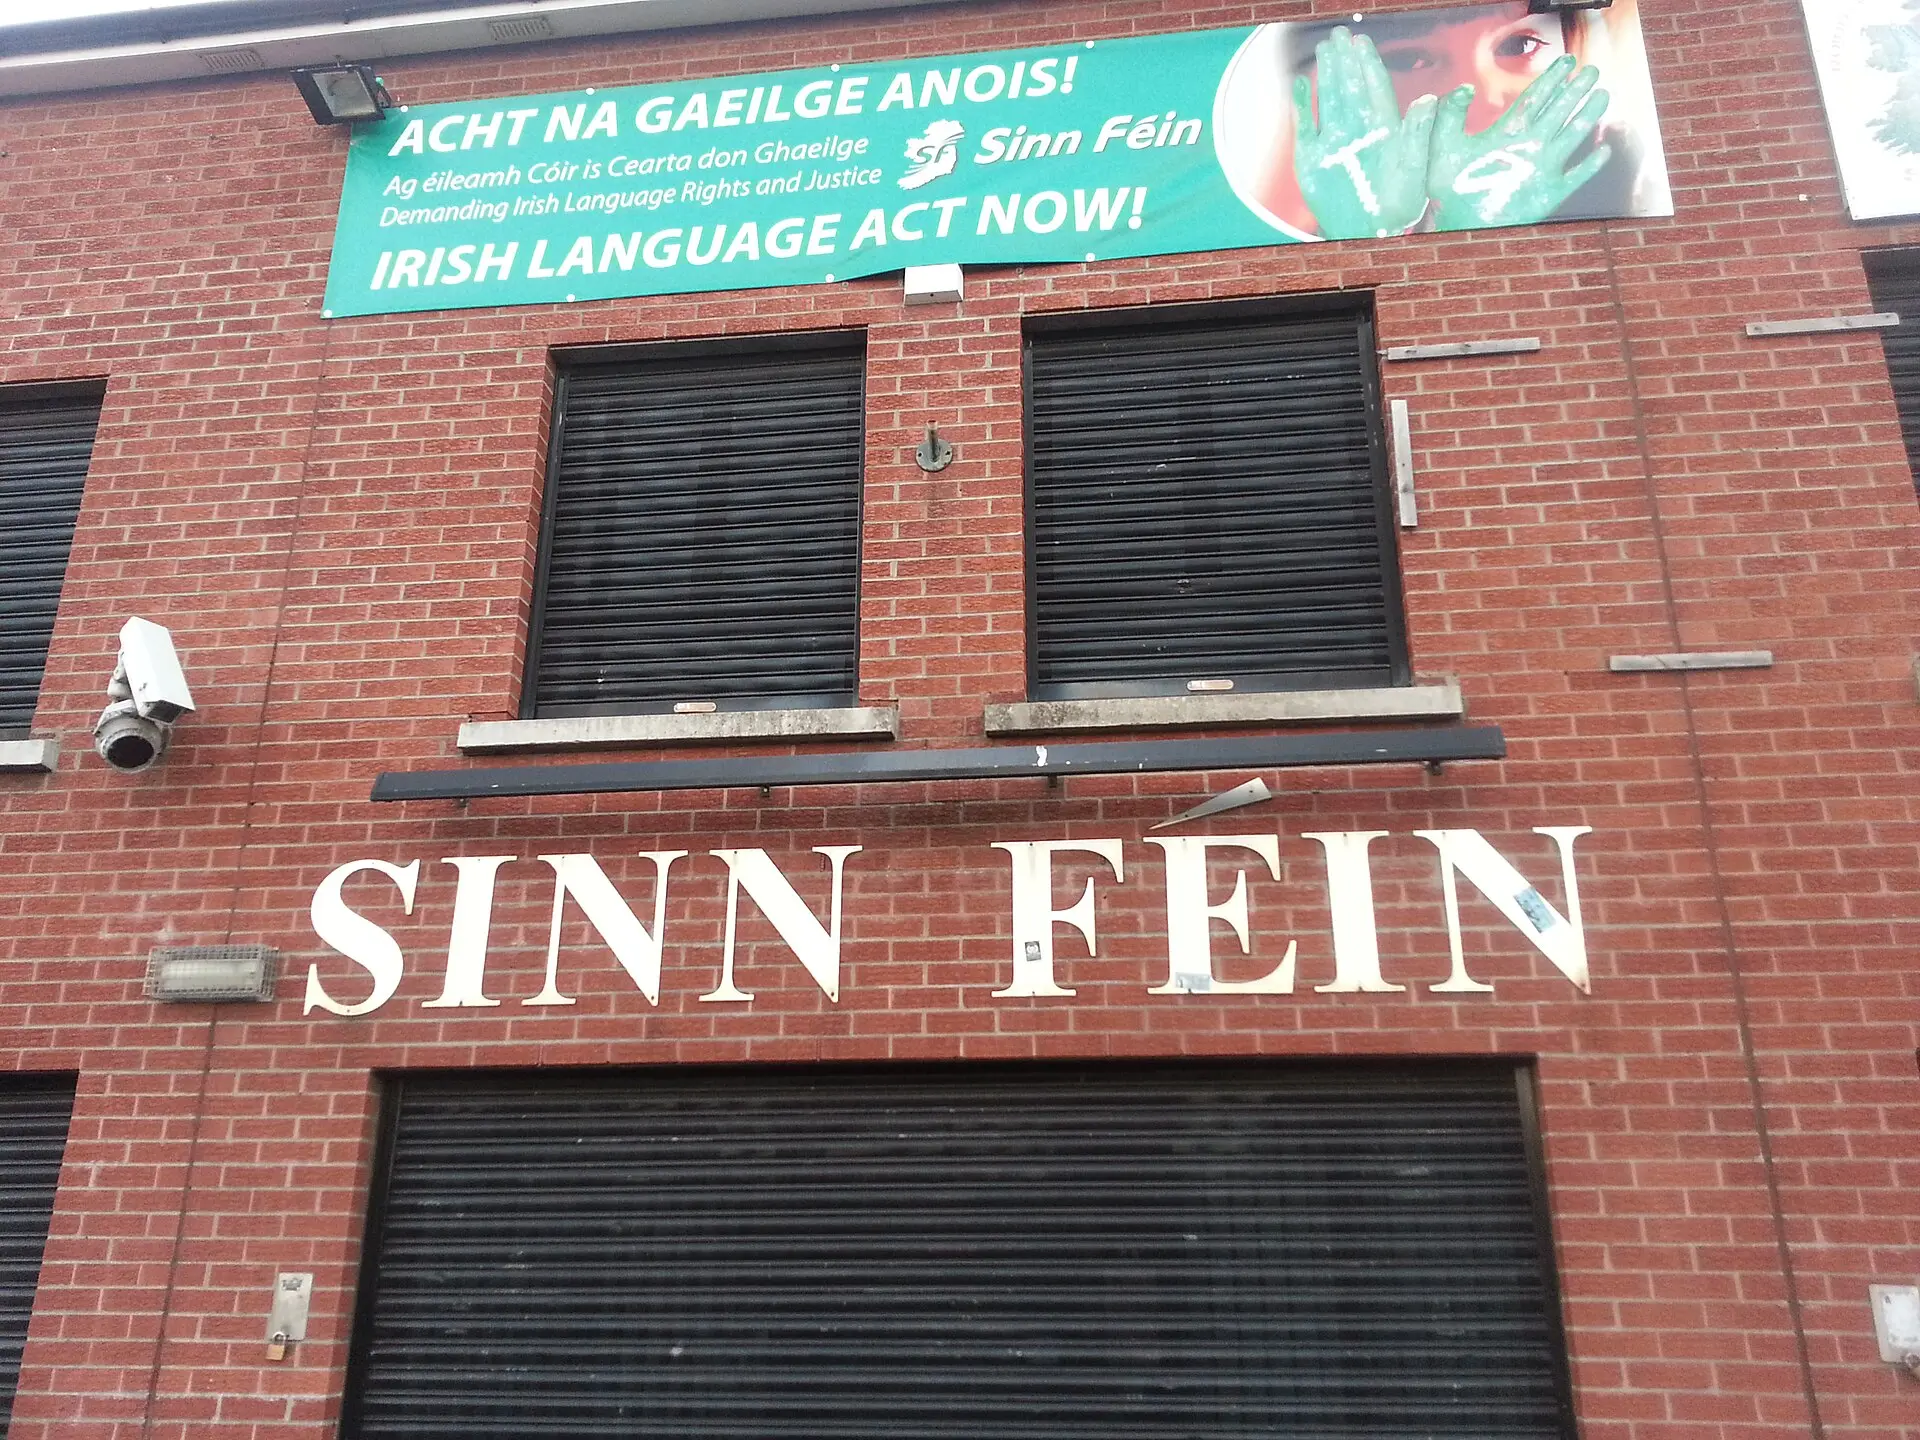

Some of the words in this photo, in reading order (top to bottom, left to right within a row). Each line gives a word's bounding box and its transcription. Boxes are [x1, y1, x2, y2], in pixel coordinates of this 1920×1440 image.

[388, 108, 538, 157] ACHT
[543, 101, 618, 143] NA
[635, 77, 868, 134] GAEILGE
[876, 55, 1079, 112] ANOIS!
[973, 125, 1082, 165] Sinn
[1093, 110, 1202, 153] Féin
[379, 197, 506, 228] Demanding
[511, 189, 559, 215] Irish
[564, 181, 676, 213] Language
[681, 173, 751, 203] Rights
[756, 169, 800, 194] and
[803, 166, 882, 190] Justice
[383, 175, 415, 201] Ag
[423, 165, 521, 194] éileamh
[528, 159, 579, 186] Cóir
[582, 157, 601, 181] is
[608, 149, 690, 177] Cearta
[697, 145, 746, 170] don
[754, 134, 870, 167] Ghaeilge
[370, 241, 518, 291] IRISH
[526, 213, 839, 277] LANGUAGE
[849, 197, 967, 251] ACT
[976, 186, 1147, 236] NOW!
[303, 844, 863, 1016] SINN
